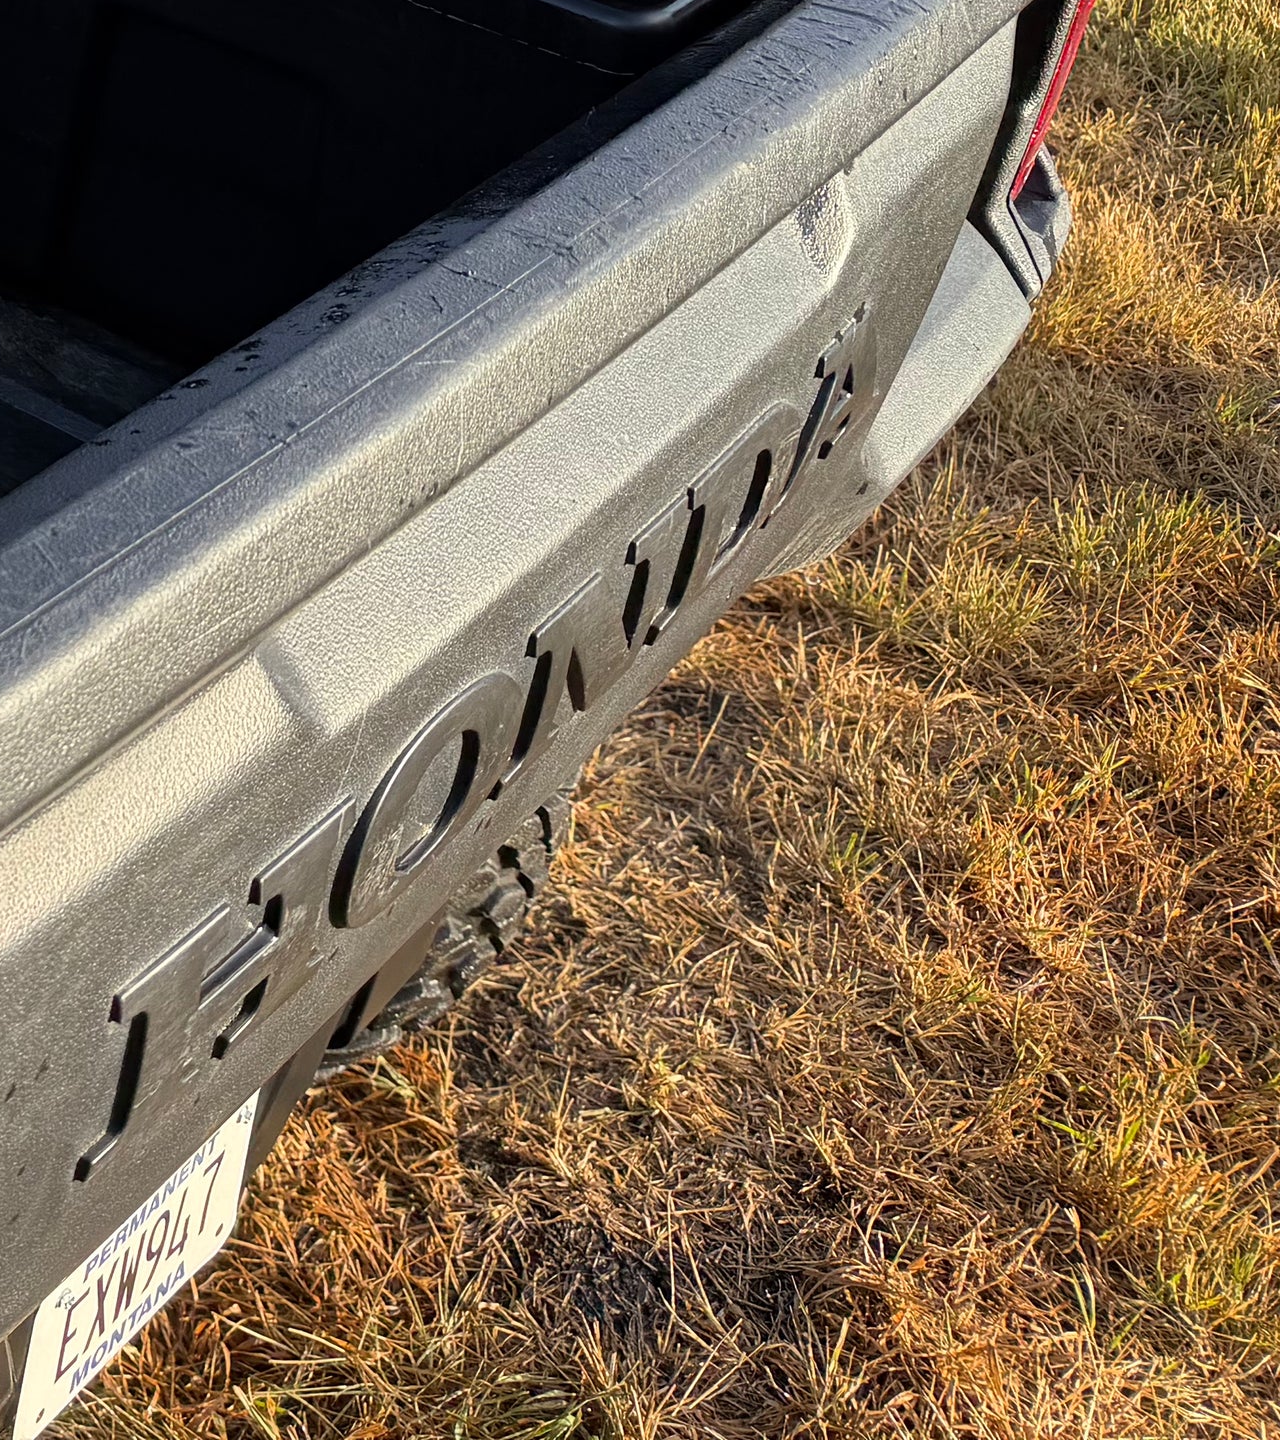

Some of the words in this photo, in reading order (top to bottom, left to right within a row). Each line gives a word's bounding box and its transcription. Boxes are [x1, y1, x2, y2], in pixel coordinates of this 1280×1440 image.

[74, 302, 878, 1182] HONDA
[54, 1150, 225, 1384] EXW947
[83, 1131, 221, 1283] PERMANENT
[69, 1260, 185, 1394] MONTANA
